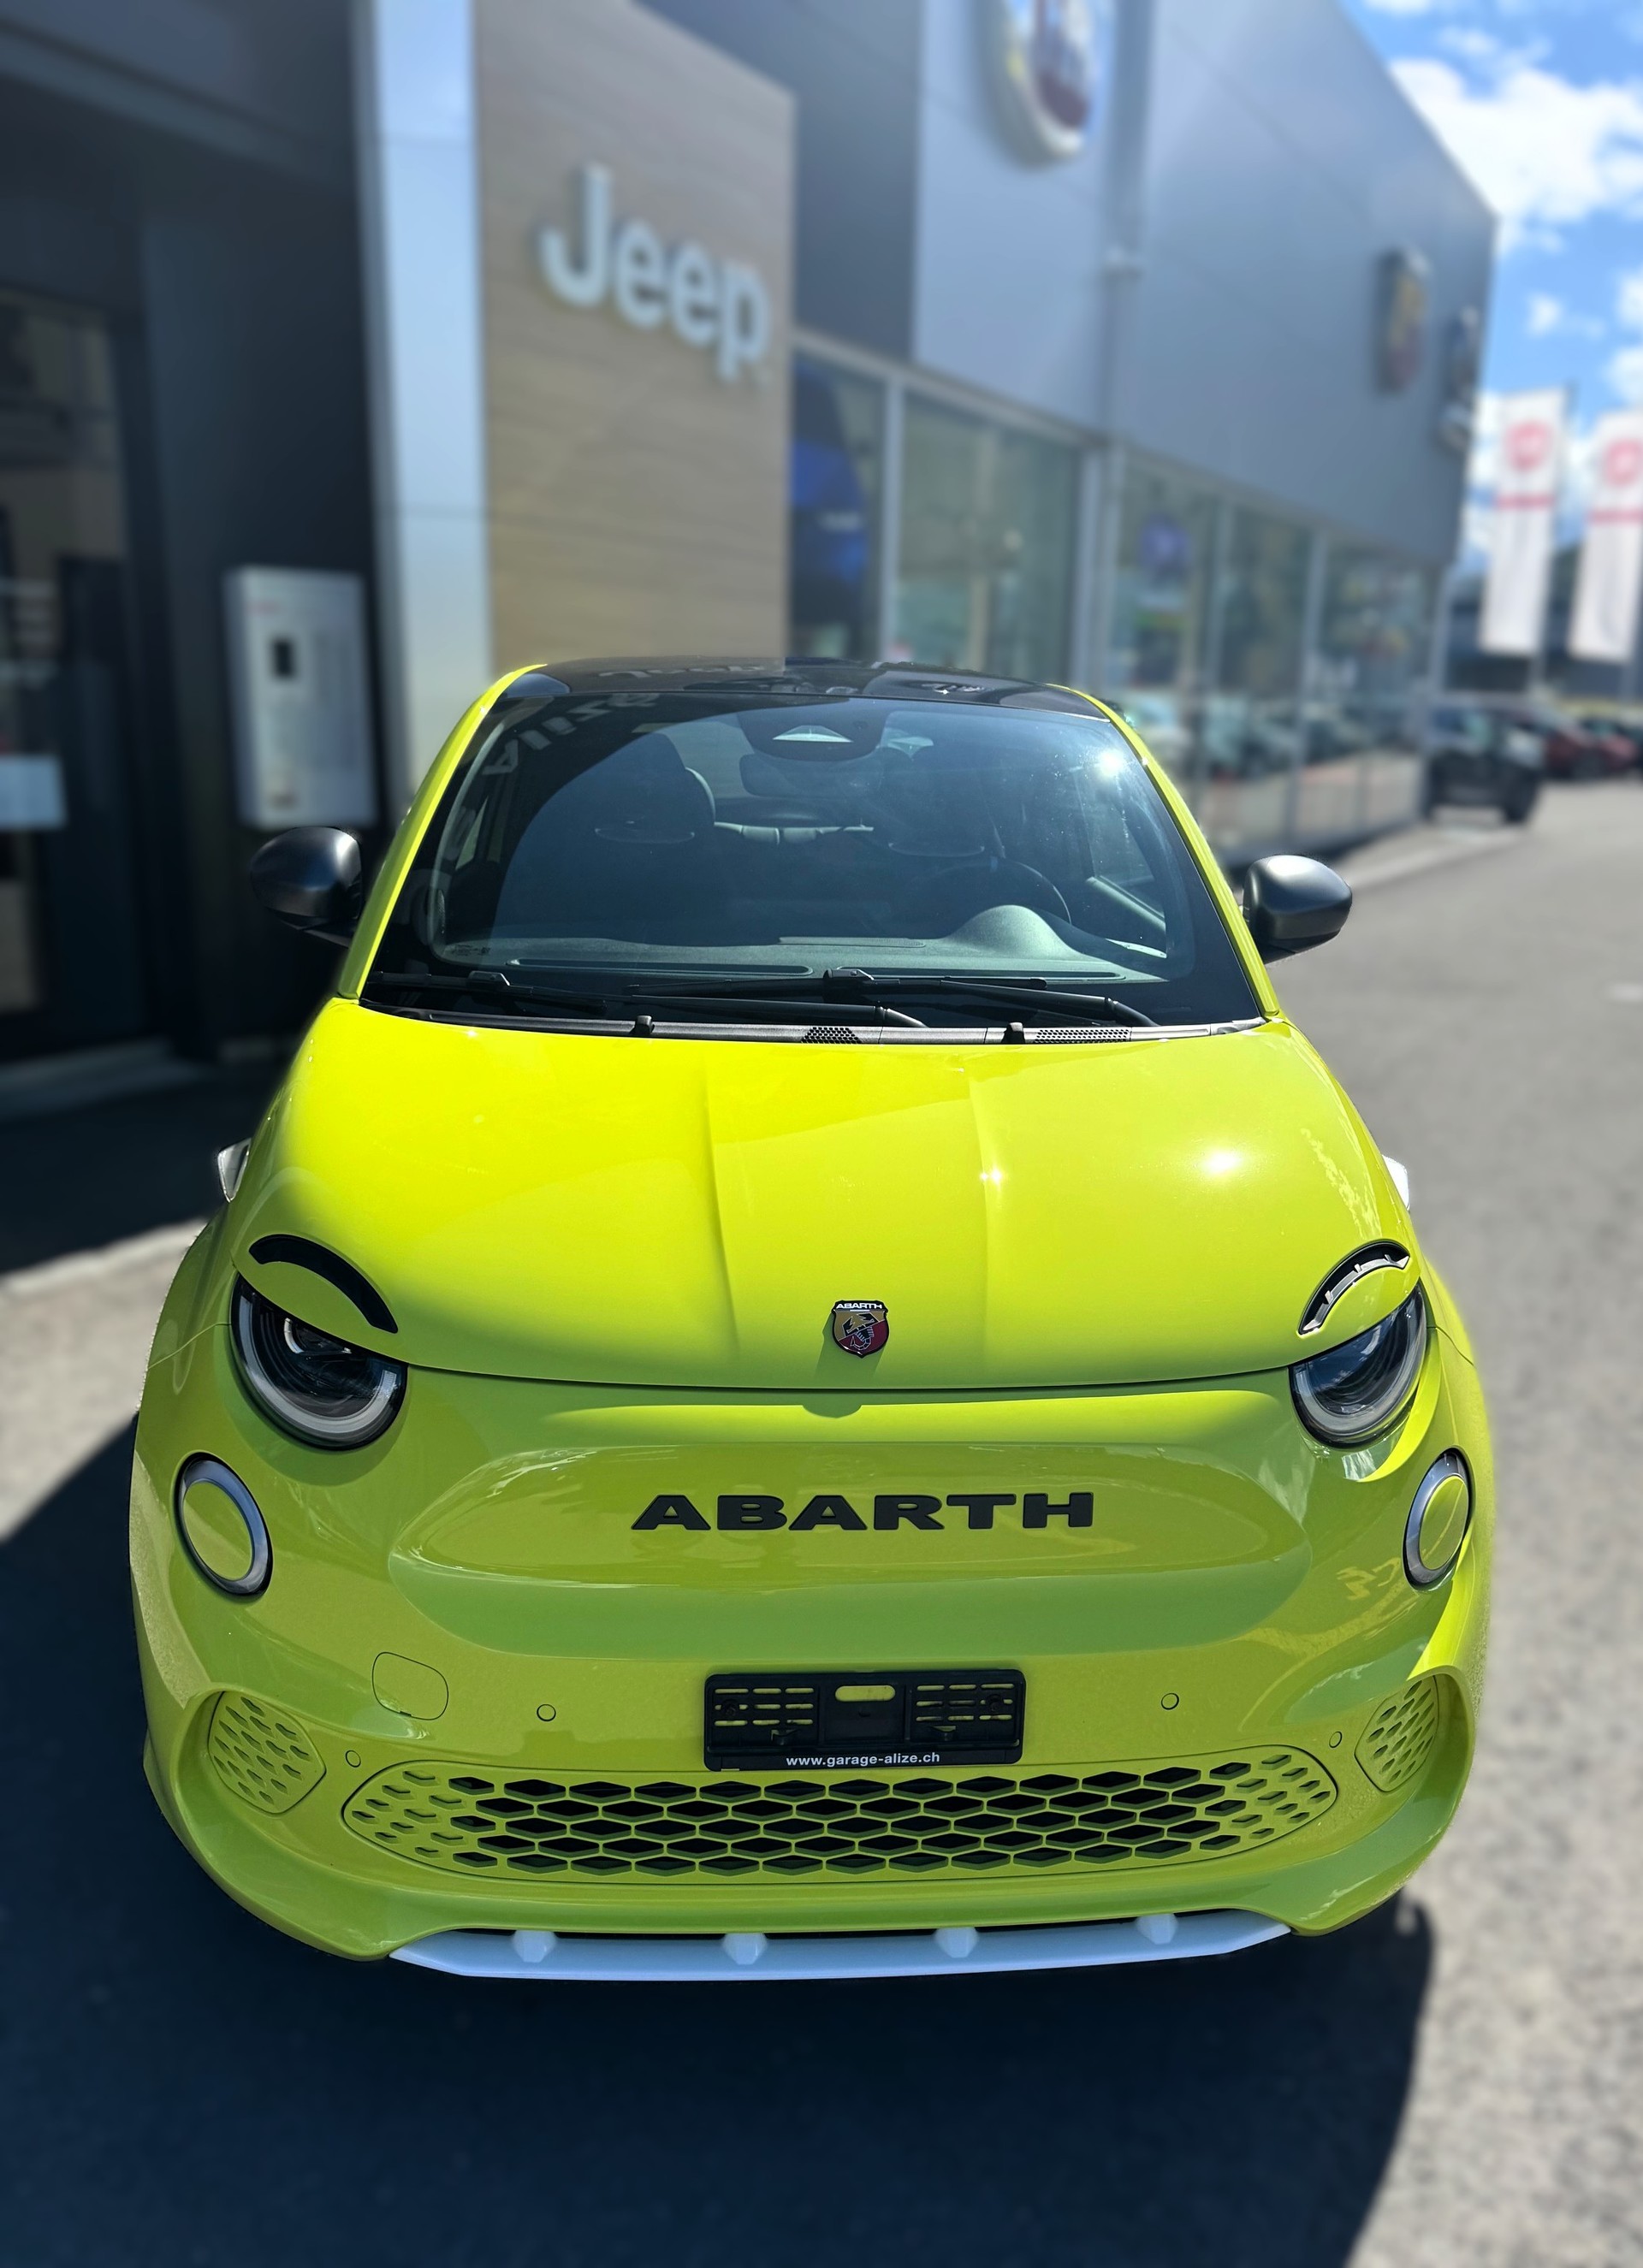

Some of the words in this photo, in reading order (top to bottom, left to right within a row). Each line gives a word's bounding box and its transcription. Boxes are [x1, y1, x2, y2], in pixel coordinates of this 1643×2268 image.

[539, 162, 769, 381] Jeep
[631, 1492, 1094, 1531] ABARTH
[786, 1751, 940, 1767] www.garage-alize.ch
